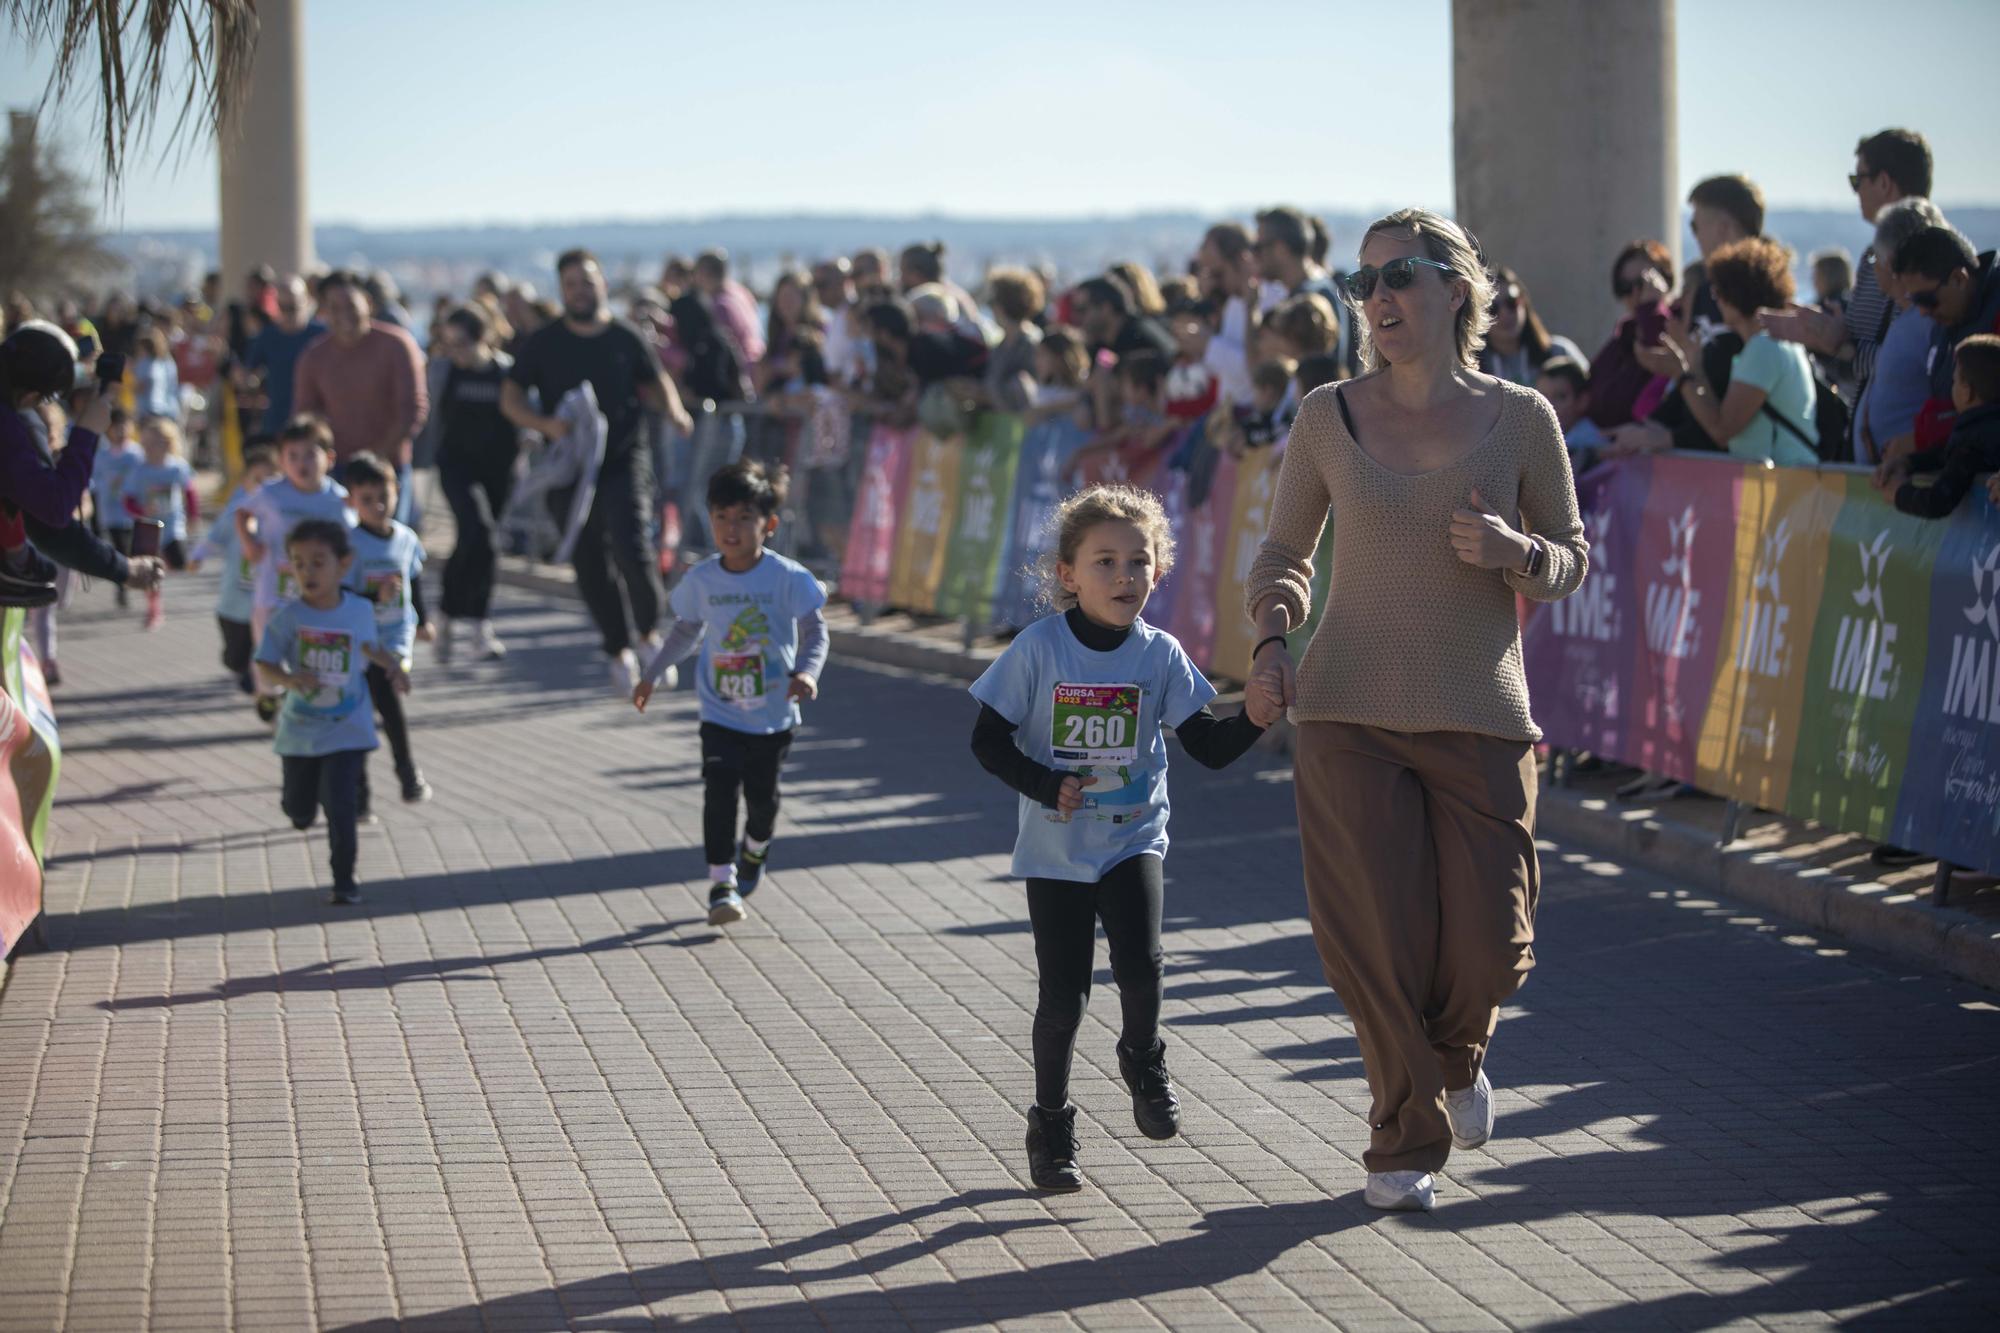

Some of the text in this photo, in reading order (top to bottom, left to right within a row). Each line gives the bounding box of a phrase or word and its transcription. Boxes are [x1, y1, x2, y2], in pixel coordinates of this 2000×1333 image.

[1829, 615, 1897, 700] IME
[720, 674, 755, 697] 428
[1058, 688, 1095, 697] CURSA
[1057, 696, 1081, 704] 2023
[1064, 715, 1125, 747] 260
